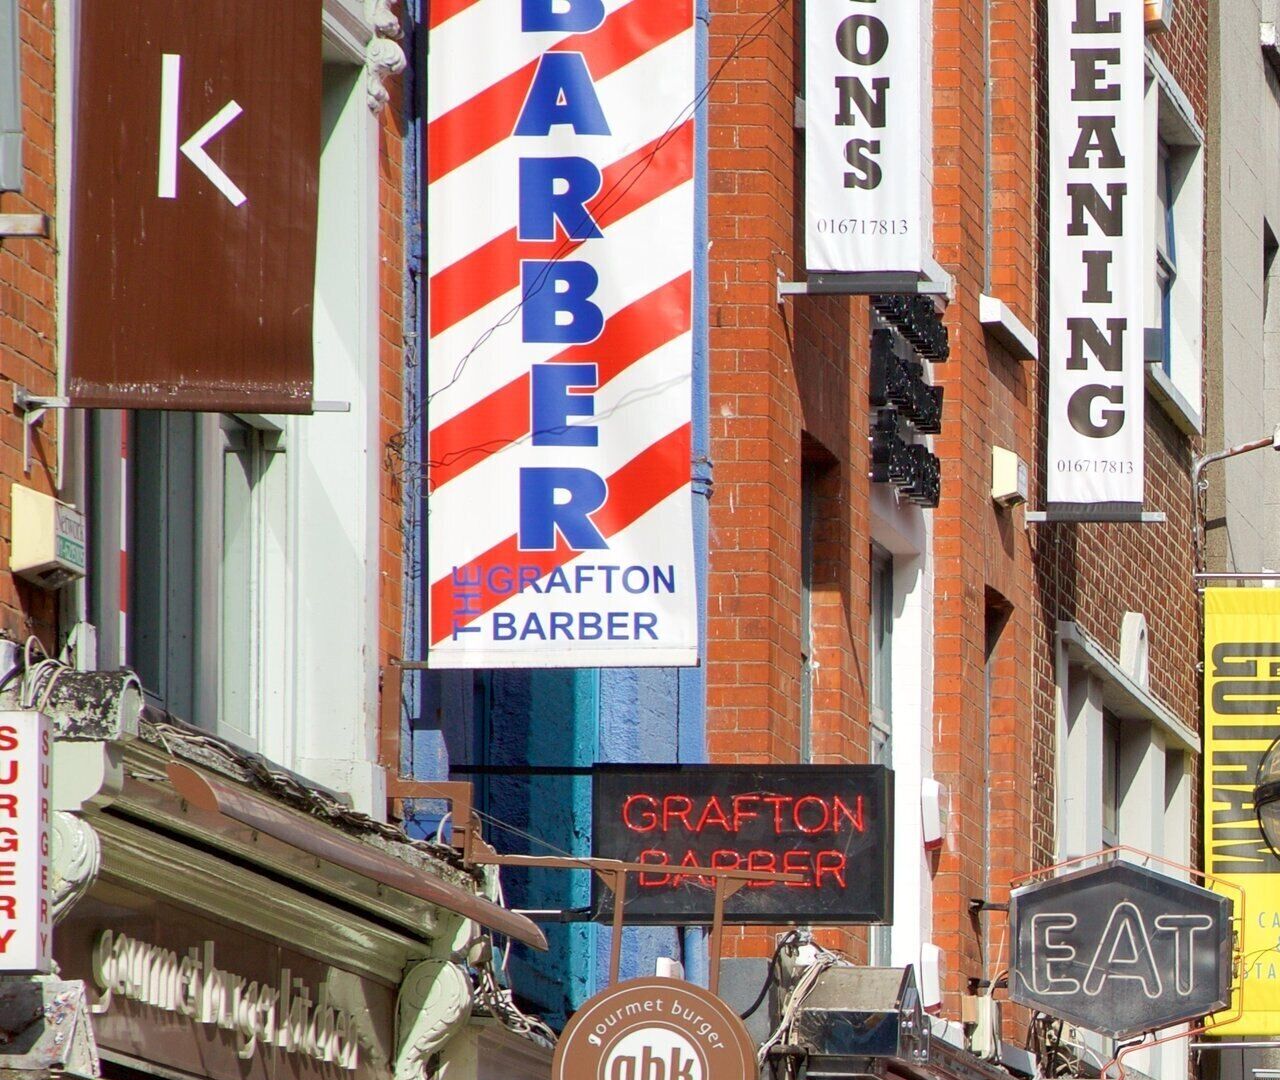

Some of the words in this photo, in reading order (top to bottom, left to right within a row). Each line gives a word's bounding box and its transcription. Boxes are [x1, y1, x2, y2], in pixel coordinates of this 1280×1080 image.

[816, 216, 909, 236] 016717813
[1056, 458, 1134, 476] 016717813
[486, 565, 676, 594] GRAFTON
[452, 565, 482, 641] THE
[492, 612, 660, 641] BARBER
[622, 793, 865, 834] GRAFTON
[40, 729, 50, 958] SURGERY
[638, 849, 847, 889] BARBER
[1029, 901, 1213, 999] EAT
[587, 998, 663, 1048] gourmet
[671, 999, 725, 1051] burger
